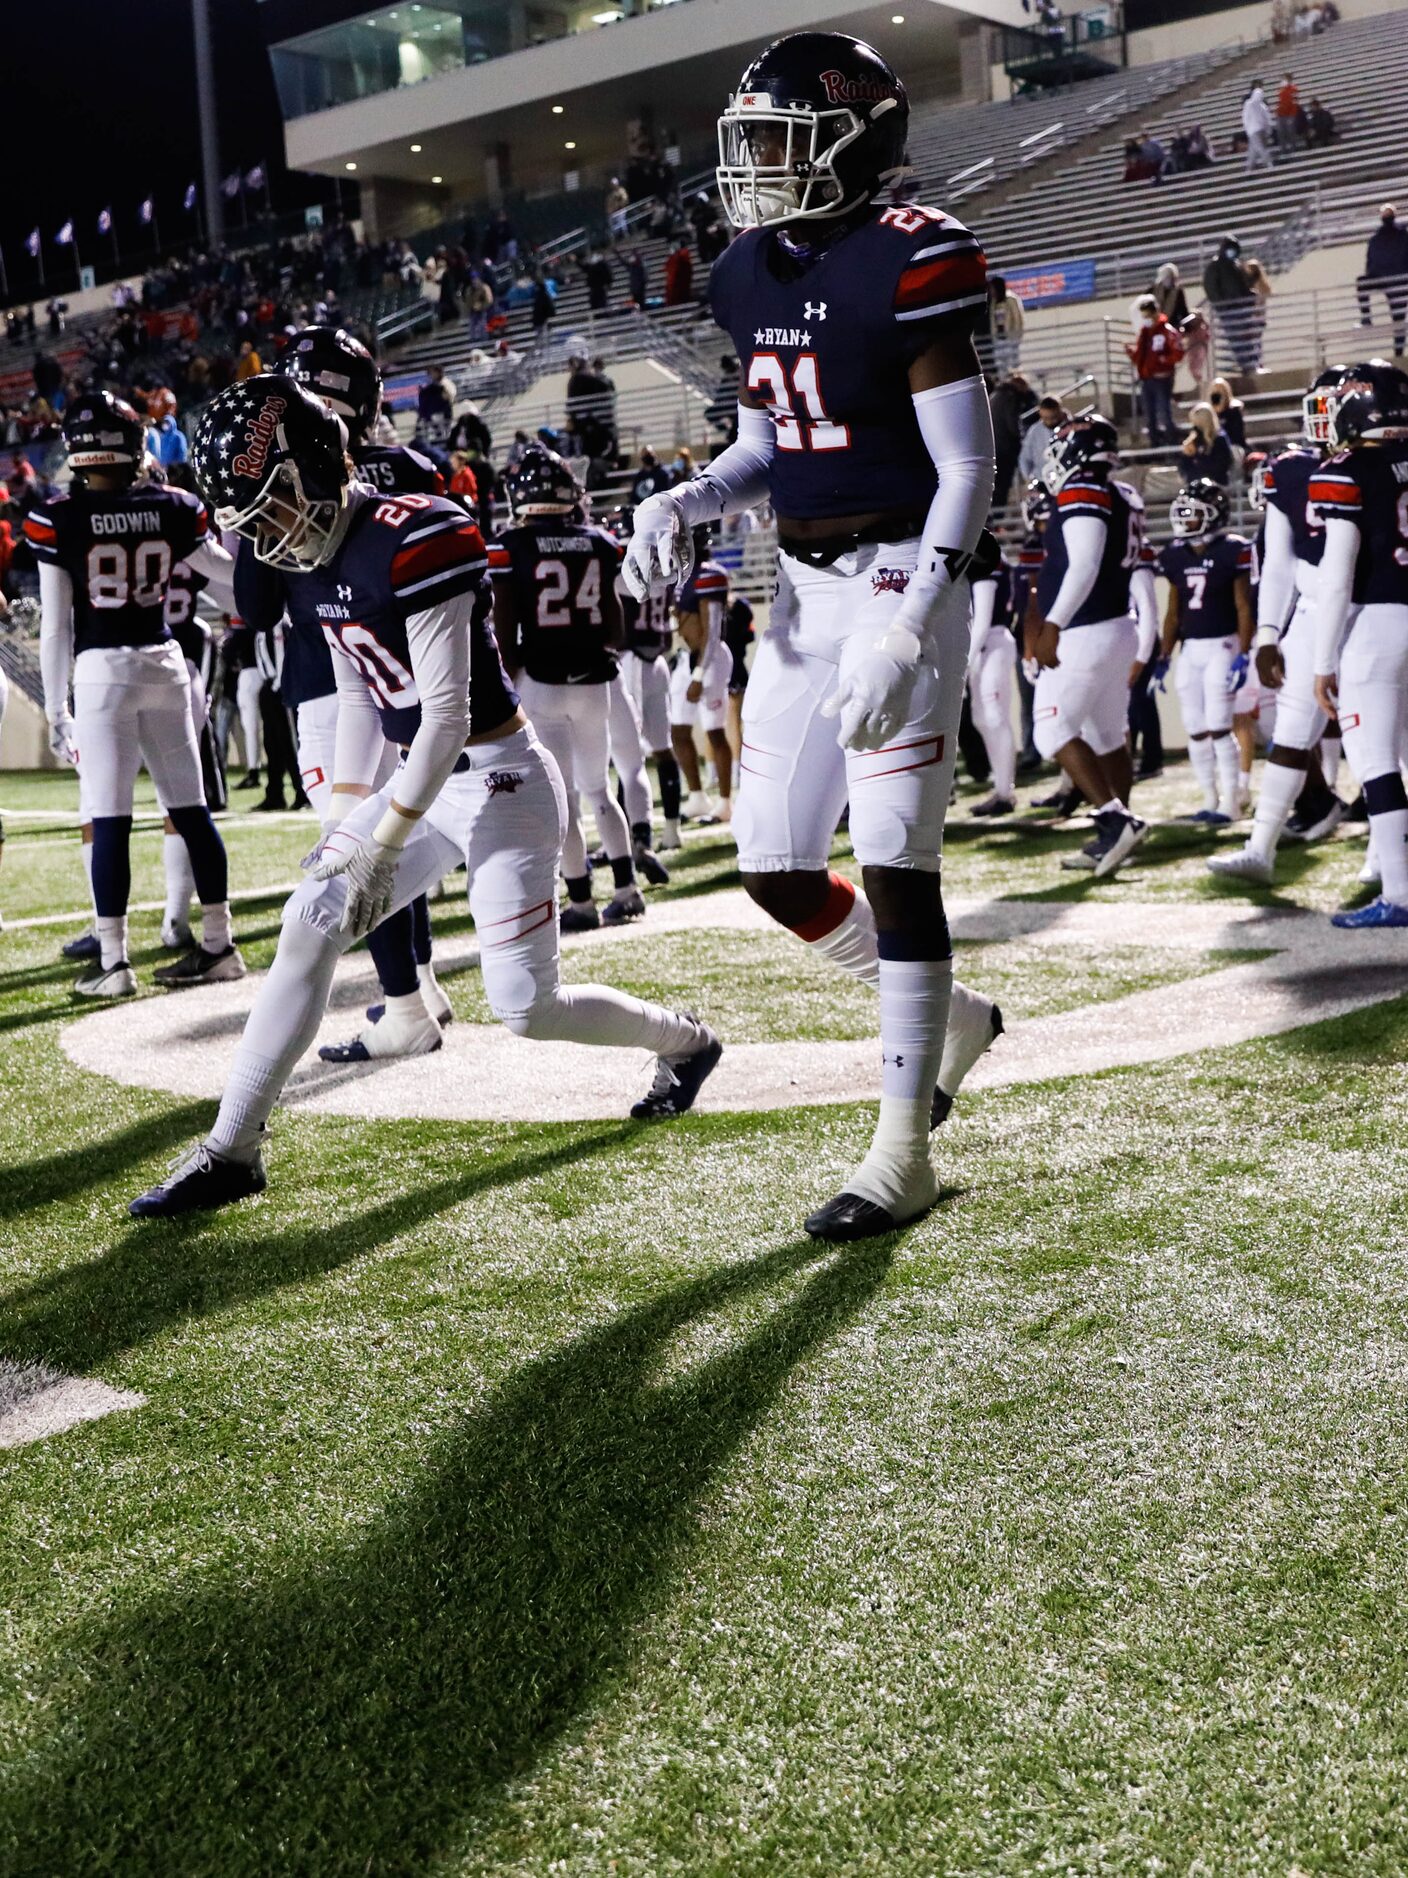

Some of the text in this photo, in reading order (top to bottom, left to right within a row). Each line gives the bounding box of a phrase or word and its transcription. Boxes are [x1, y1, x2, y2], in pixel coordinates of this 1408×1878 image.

[742, 96, 756, 106] ONE
[819, 70, 902, 105] Raid
[764, 328, 801, 346] RYAN
[747, 352, 852, 453] 21
[233, 395, 288, 481] Raiders
[91, 511, 161, 535] GODWIN
[372, 494, 434, 529] 20
[536, 536, 593, 553] HUTCHINSON
[87, 539, 172, 609] 80
[1186, 573, 1206, 610] 7
[534, 558, 603, 628] 24
[319, 604, 344, 618] RYAN
